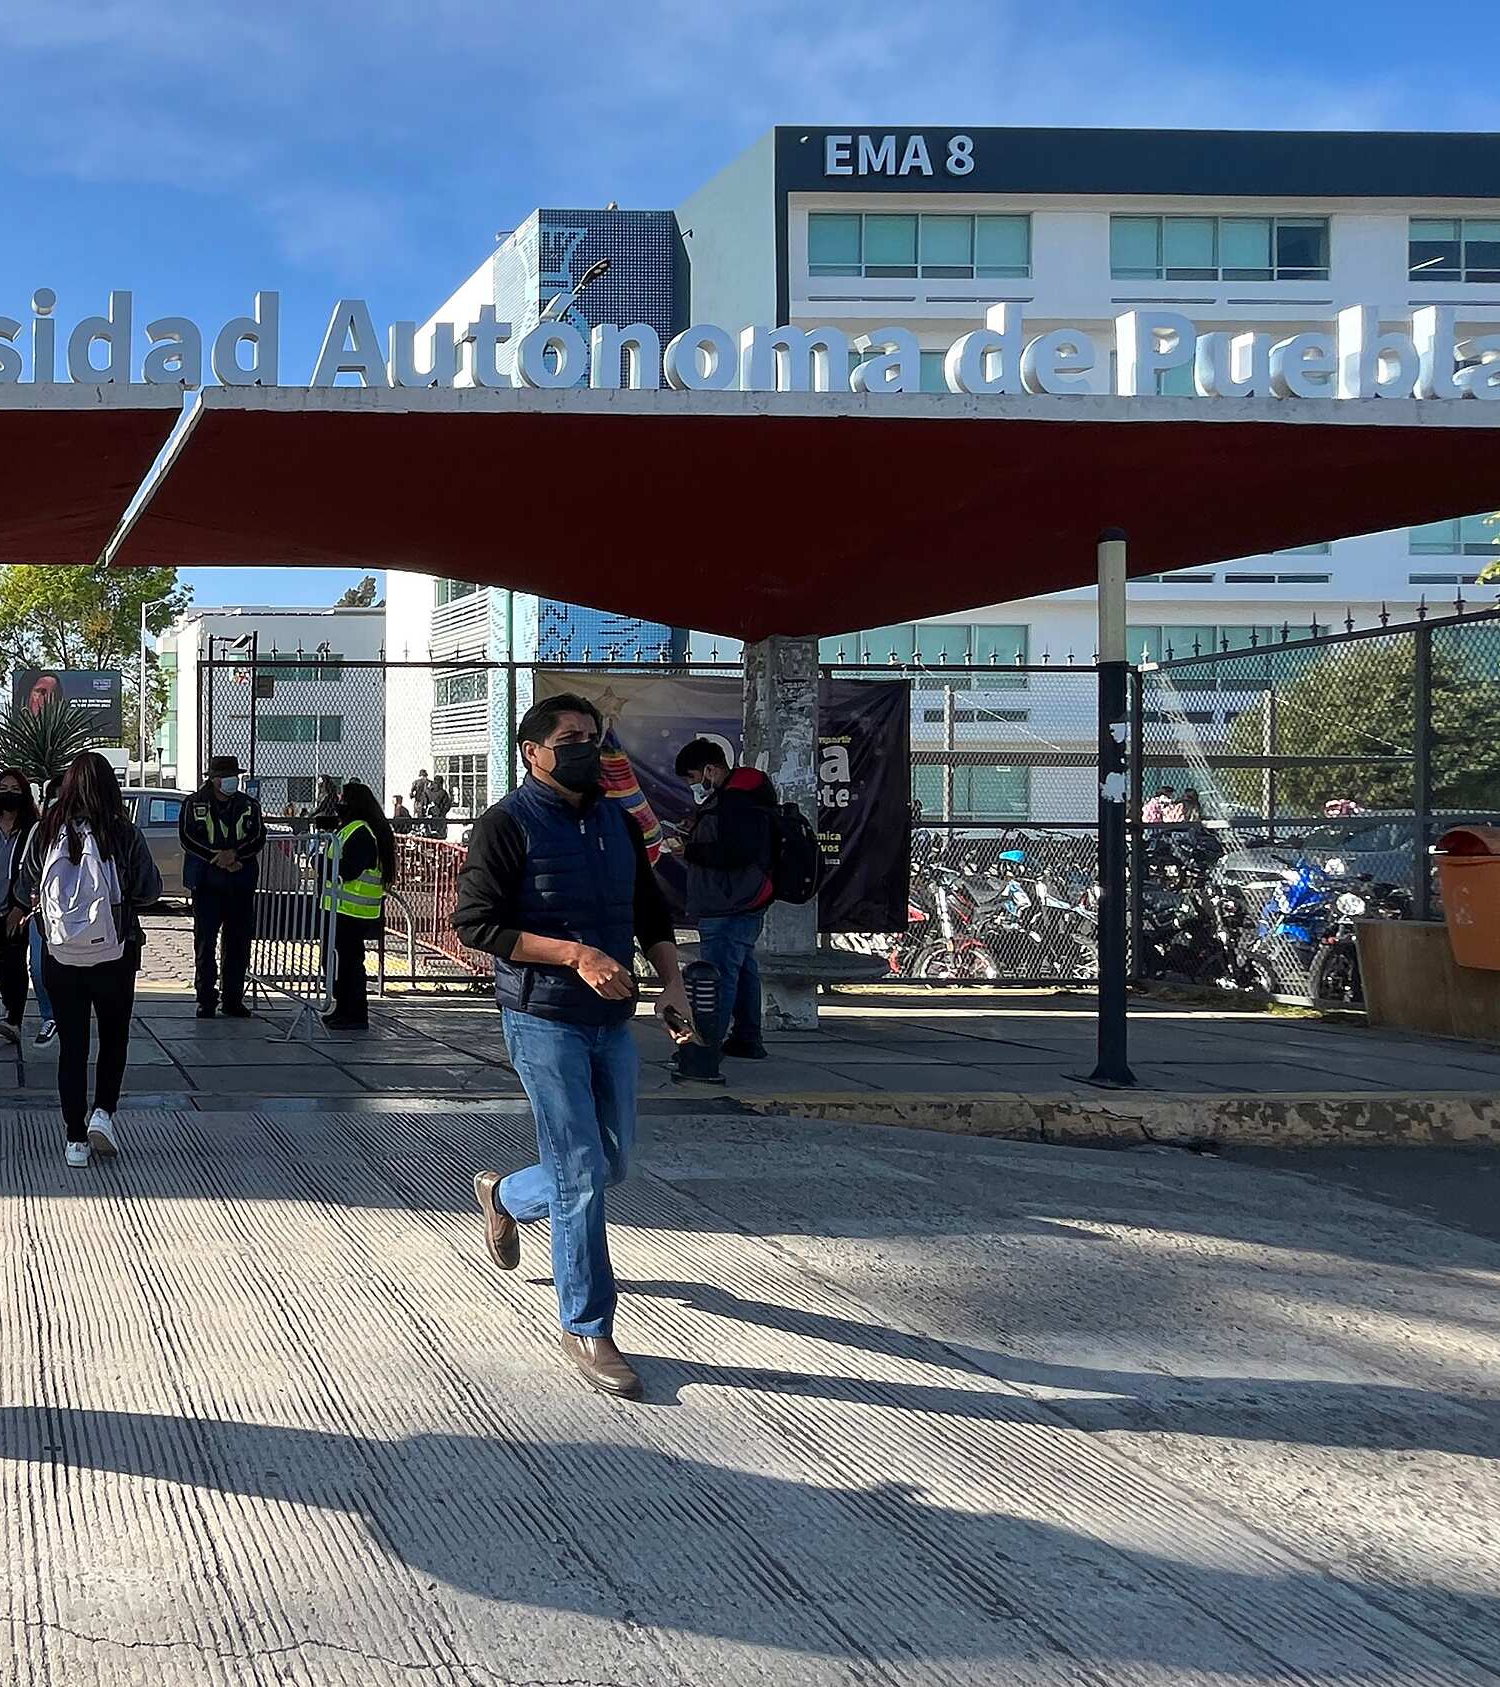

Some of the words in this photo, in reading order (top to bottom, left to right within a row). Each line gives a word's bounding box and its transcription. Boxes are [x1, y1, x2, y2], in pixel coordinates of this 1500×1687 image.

[824, 135, 934, 176] EMA
[946, 135, 975, 176] 8
[310, 292, 922, 394] Autónoma
[943, 302, 1096, 395] de
